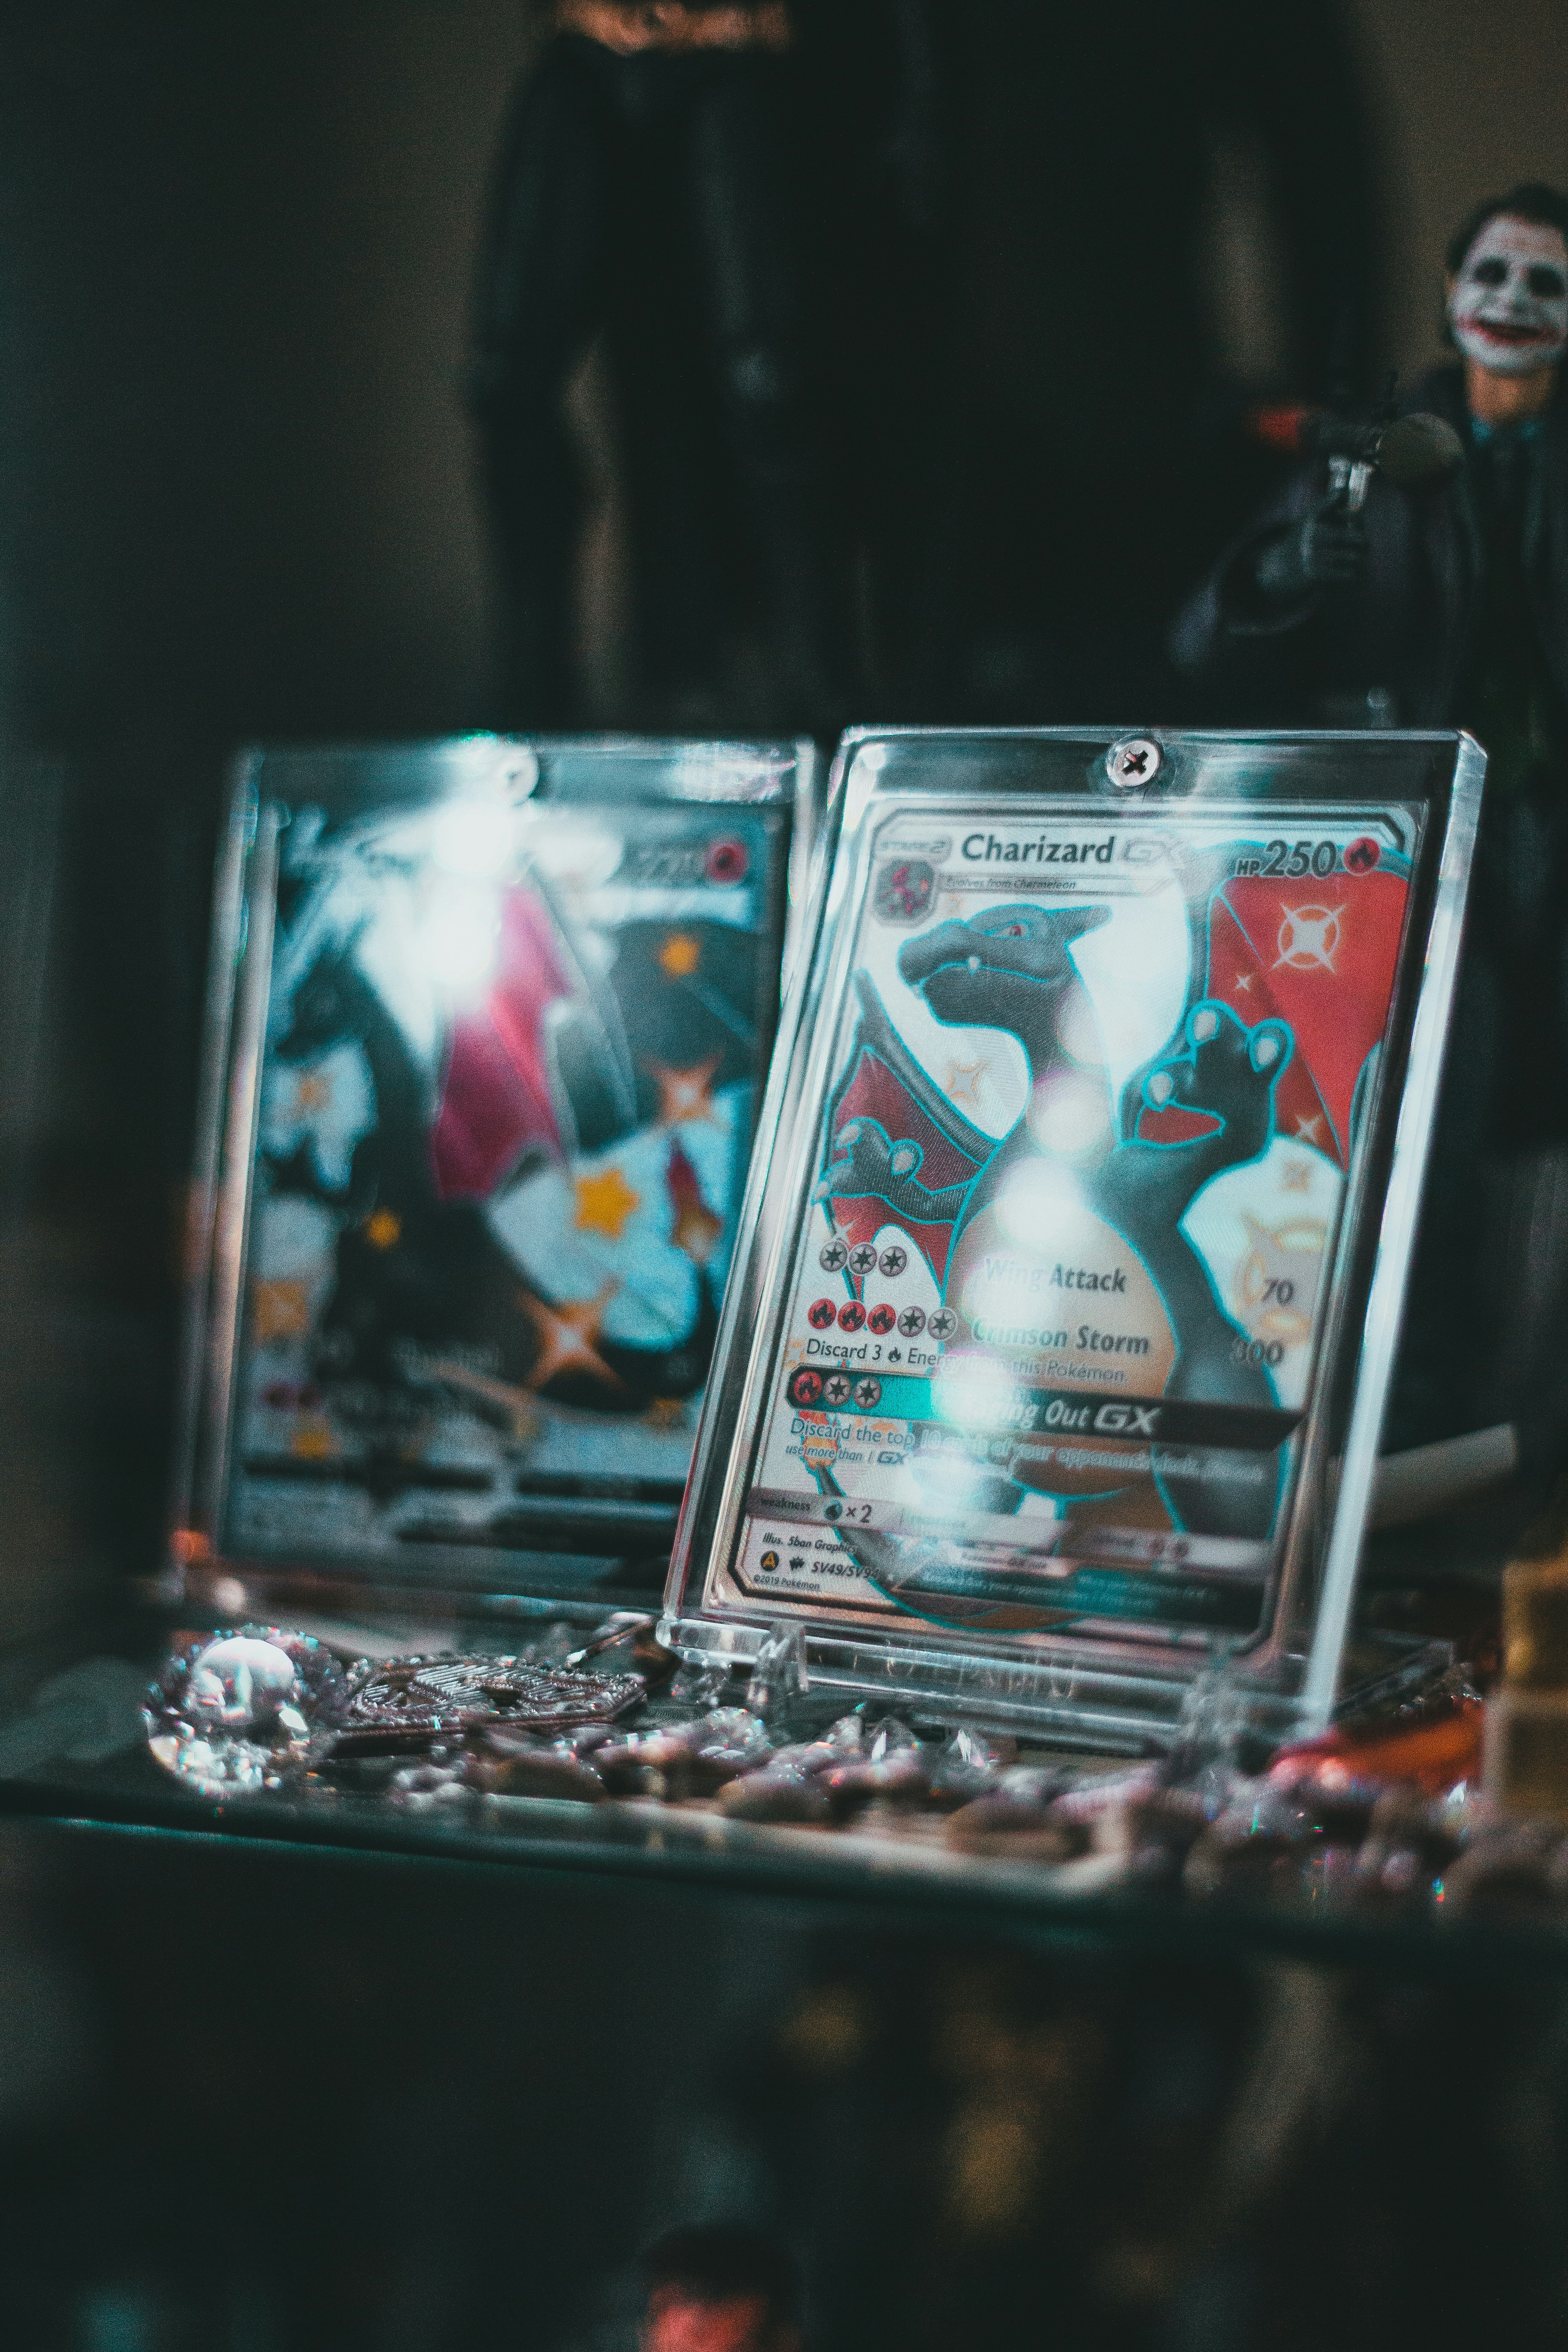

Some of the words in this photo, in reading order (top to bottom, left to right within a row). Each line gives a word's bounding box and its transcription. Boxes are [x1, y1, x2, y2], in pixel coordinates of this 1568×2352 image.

[962, 834, 1116, 863] Charizard
[1237, 859, 1259, 876] HP
[1263, 839, 1337, 876] 250
[987, 878, 1012, 890] from
[1014, 878, 1076, 890] Charmeleon
[1049, 1264, 1127, 1293] Attack
[1260, 1277, 1295, 1306] 70
[806, 1338, 867, 1360] Discard
[872, 1344, 882, 1360] 3
[972, 1317, 1068, 1348] Crimson
[1075, 1324, 1150, 1355] Storm
[1046, 1400, 1089, 1427] Out
[1094, 1403, 1162, 1434] GX
[790, 1418, 851, 1441] Discard
[856, 1424, 882, 1444] the
[887, 1429, 916, 1451] top
[785, 1444, 804, 1456] use
[806, 1447, 836, 1459] more
[838, 1449, 864, 1462] than
[876, 1451, 907, 1465] GX
[760, 1497, 812, 1512] weakness
[762, 1531, 784, 1545] Illus.
[815, 1538, 858, 1553] Graphics
